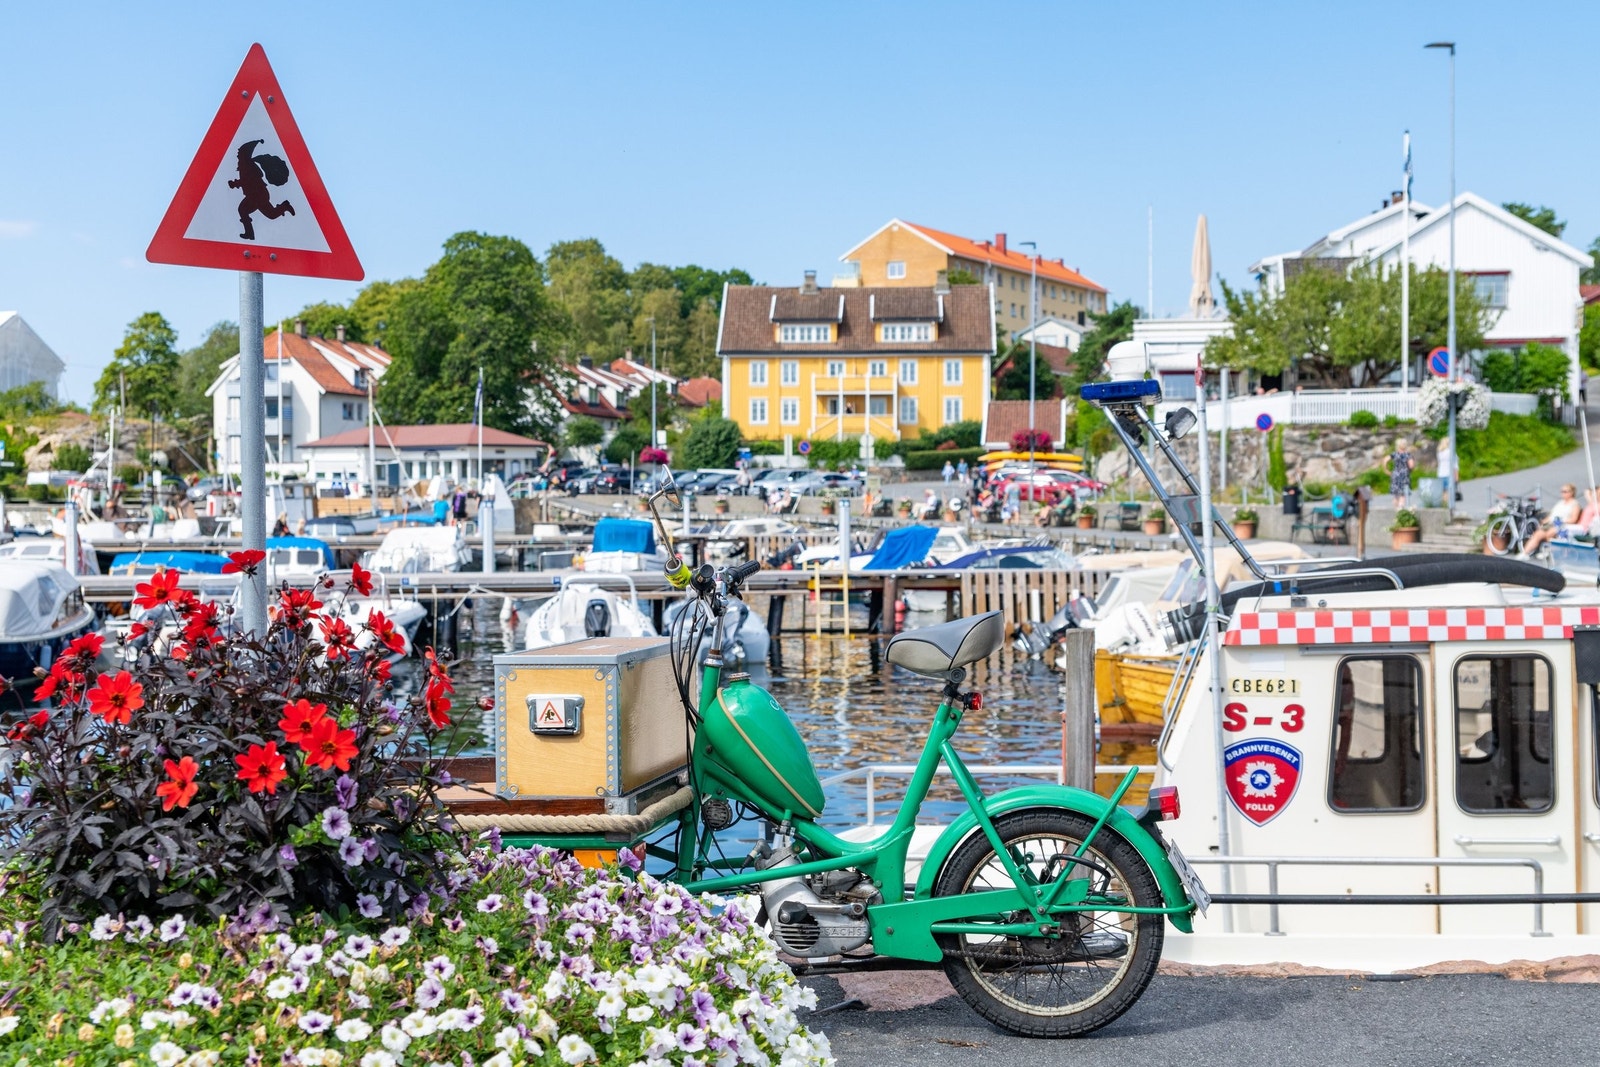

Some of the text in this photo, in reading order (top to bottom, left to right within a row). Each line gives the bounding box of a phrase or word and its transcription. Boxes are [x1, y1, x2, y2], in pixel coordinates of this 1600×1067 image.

[1222, 702, 1306, 733] S-3
[1225, 744, 1299, 764] BRANNVESENET
[1245, 803, 1275, 812] FOLLO
[824, 927, 863, 936] SACHS
